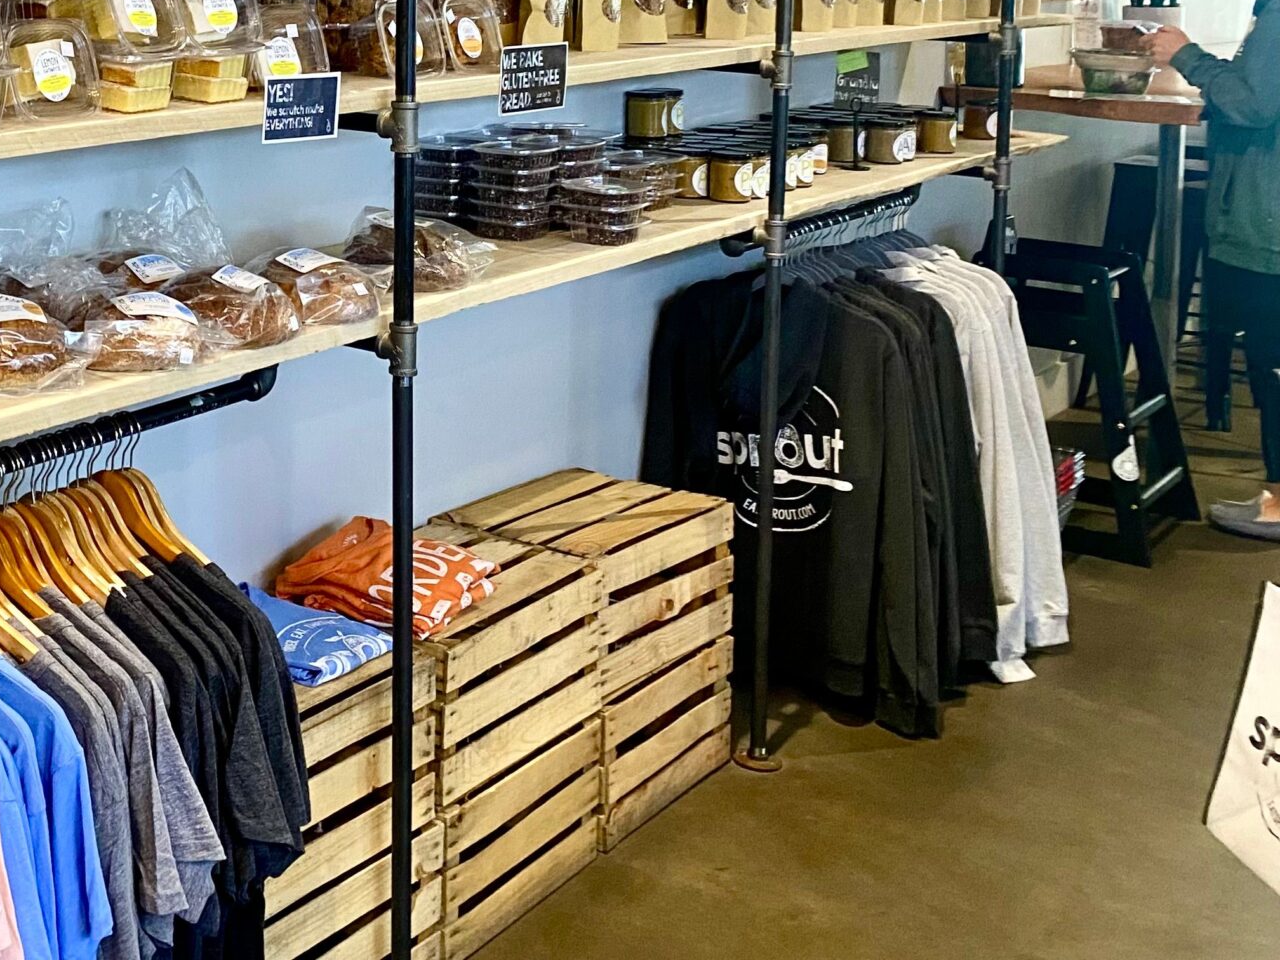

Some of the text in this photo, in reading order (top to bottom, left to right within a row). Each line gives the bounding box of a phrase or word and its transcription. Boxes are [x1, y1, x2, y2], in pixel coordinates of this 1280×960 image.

[502, 50, 544, 69] WE BAKE
[502, 68, 560, 90] GLUTEN-FREE
[268, 83, 294, 103] YES!
[267, 103, 324, 117] We scratch make
[265, 116, 314, 131] EVERYTHING!
